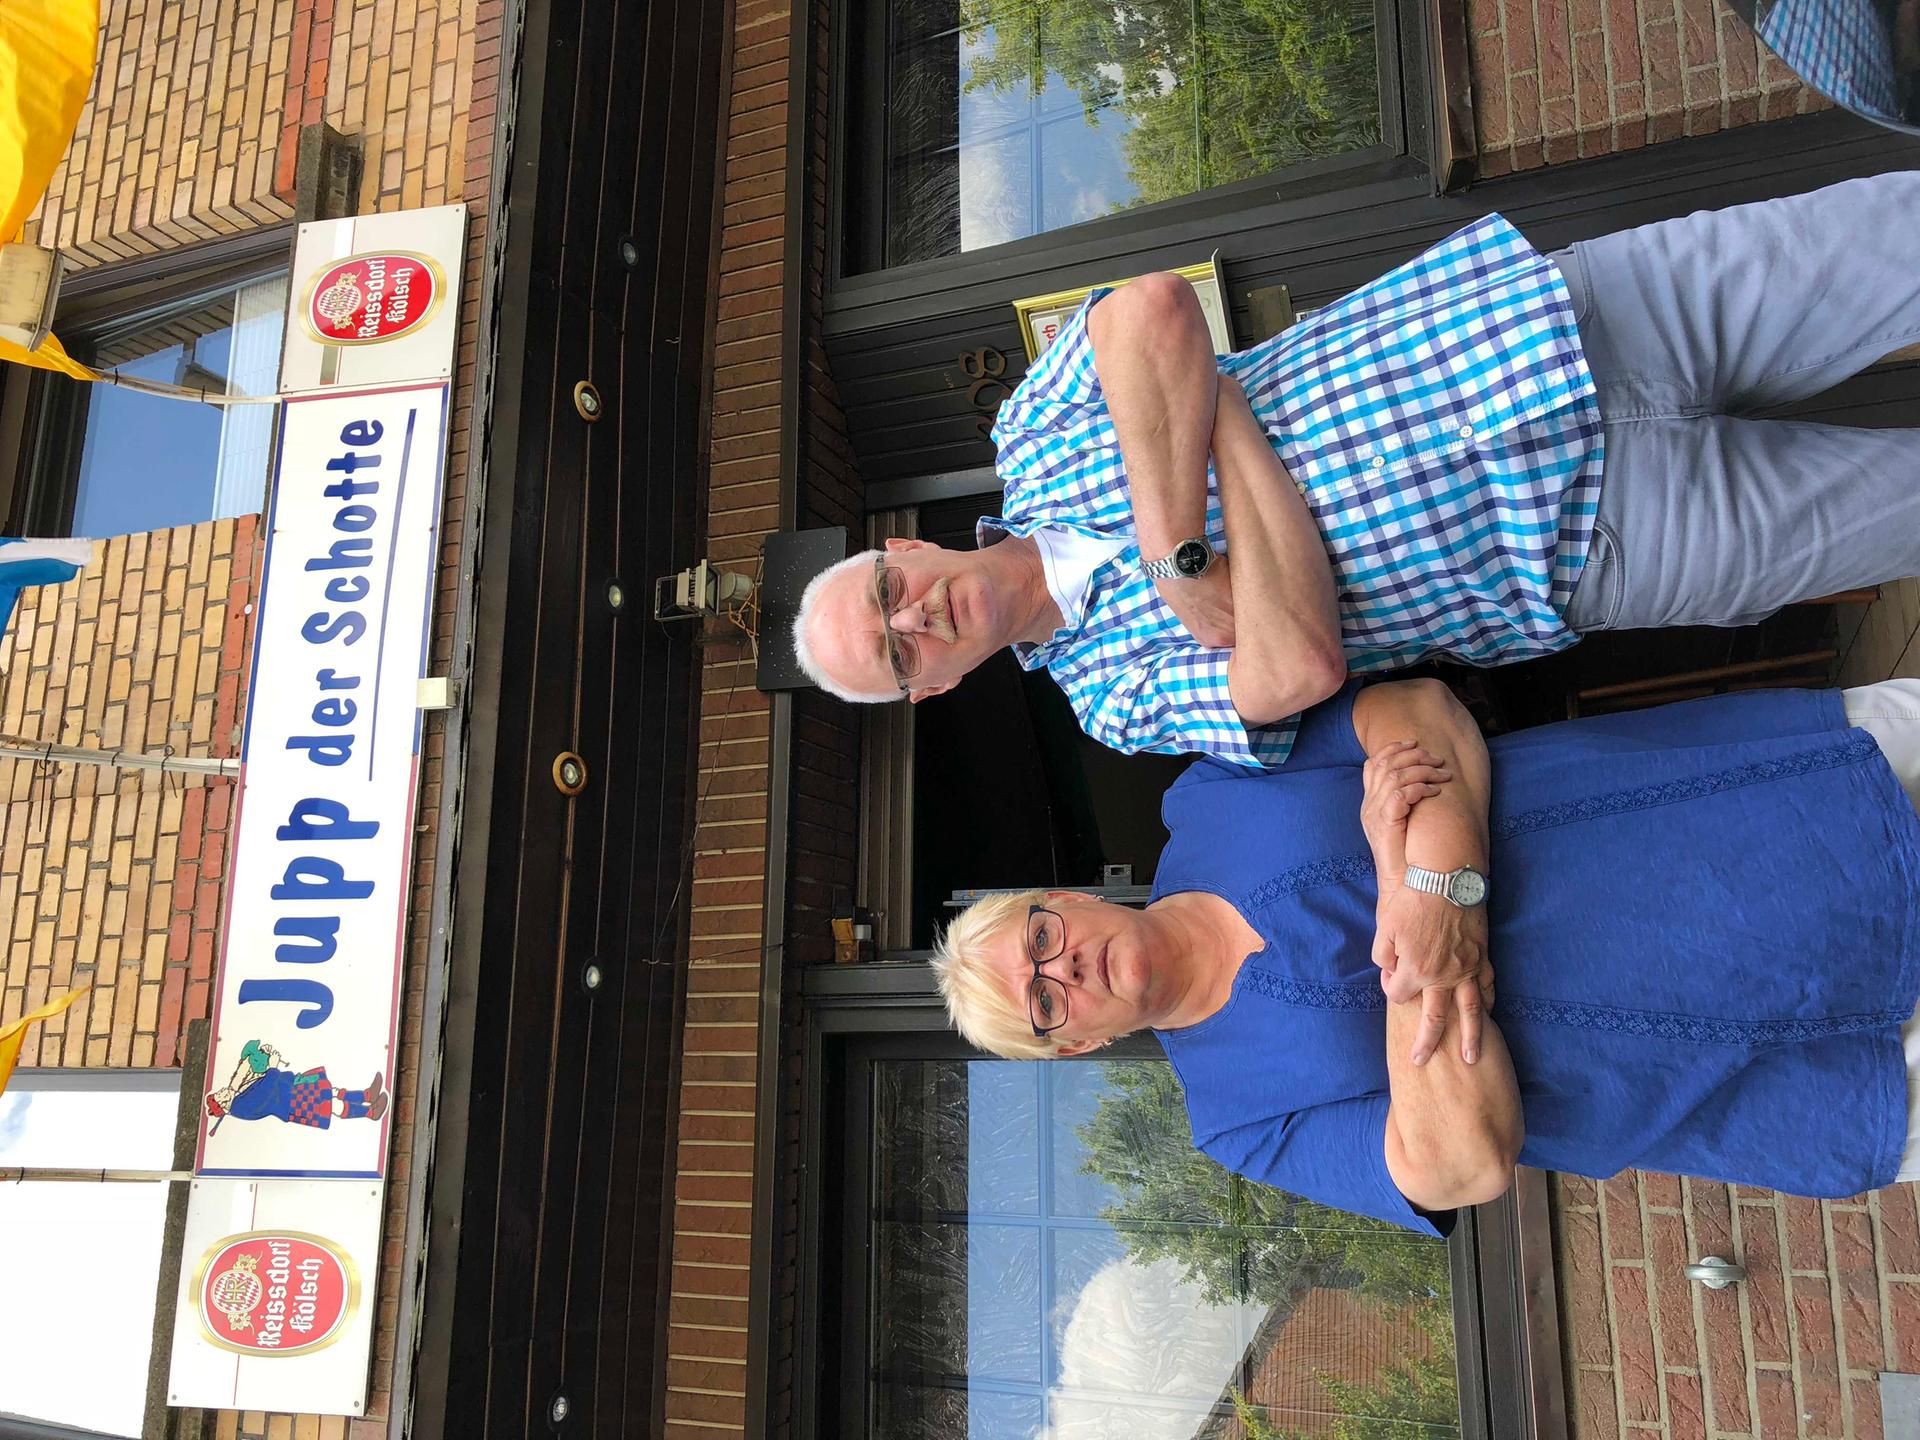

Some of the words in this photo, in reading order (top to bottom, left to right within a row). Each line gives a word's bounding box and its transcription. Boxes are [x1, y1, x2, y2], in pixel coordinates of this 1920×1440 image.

[357, 259, 386, 337] Reissdorf
[385, 267, 415, 323] Kölsch
[300, 418, 384, 645] Schotte
[286, 667, 362, 767] der
[238, 796, 380, 1030] Jupp
[256, 1241, 291, 1347] Reissdorf
[289, 1258, 324, 1333] Kölsch
